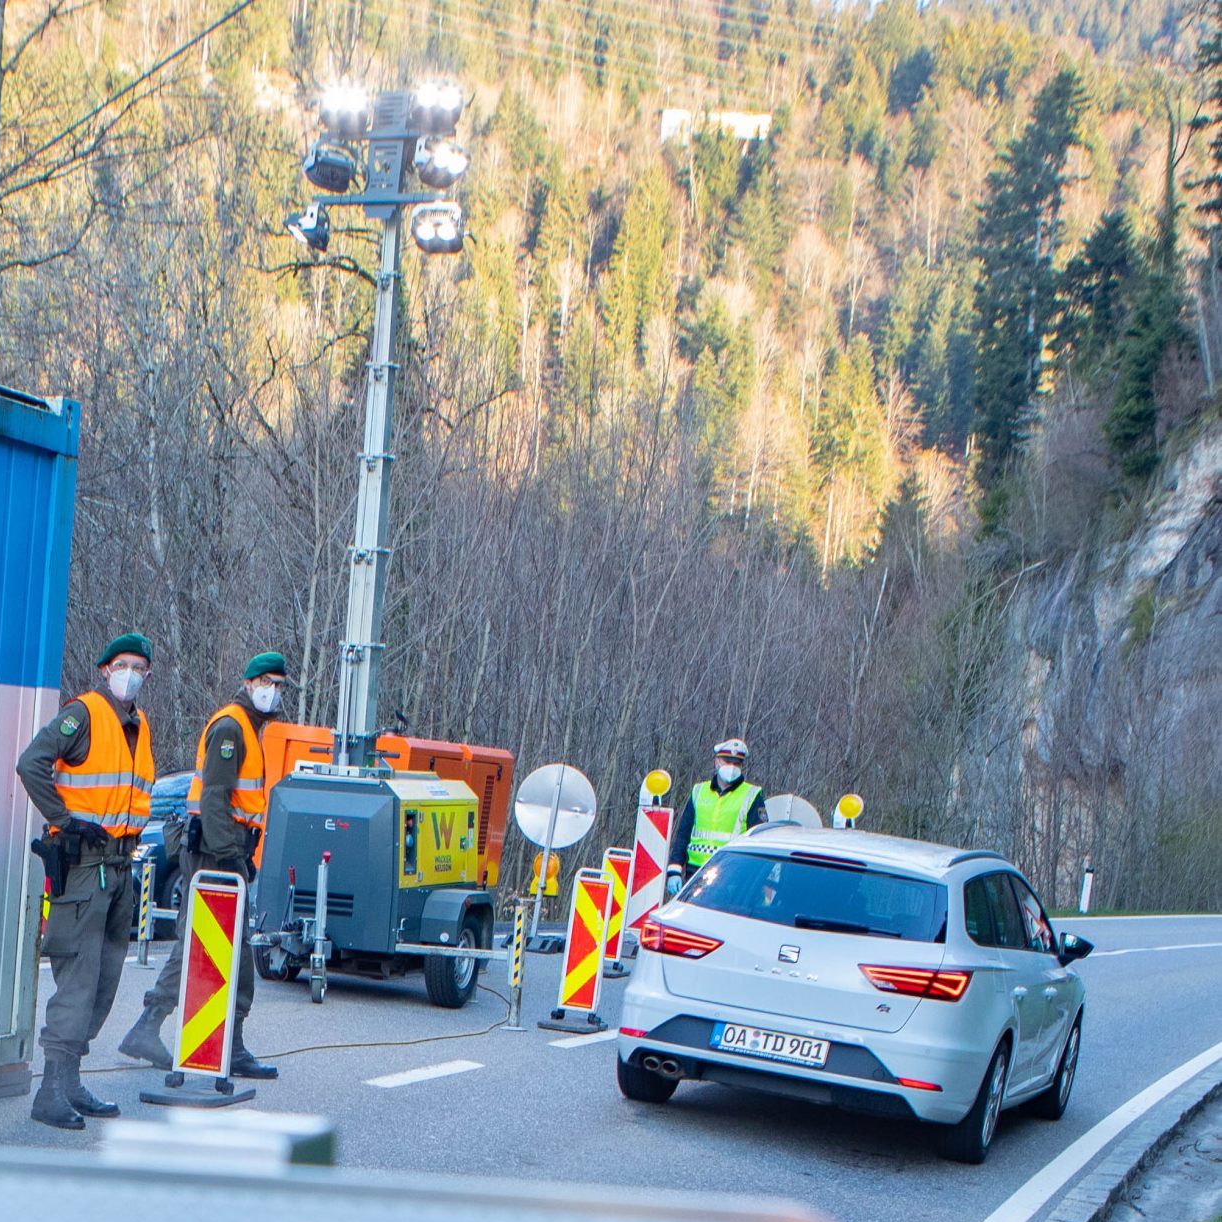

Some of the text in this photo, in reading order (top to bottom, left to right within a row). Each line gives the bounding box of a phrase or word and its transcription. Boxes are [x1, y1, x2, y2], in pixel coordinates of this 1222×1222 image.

[754, 964, 819, 982] LEON
[723, 1026, 747, 1047] OA
[762, 1032, 786, 1053] TD
[788, 1037, 823, 1061] 901
